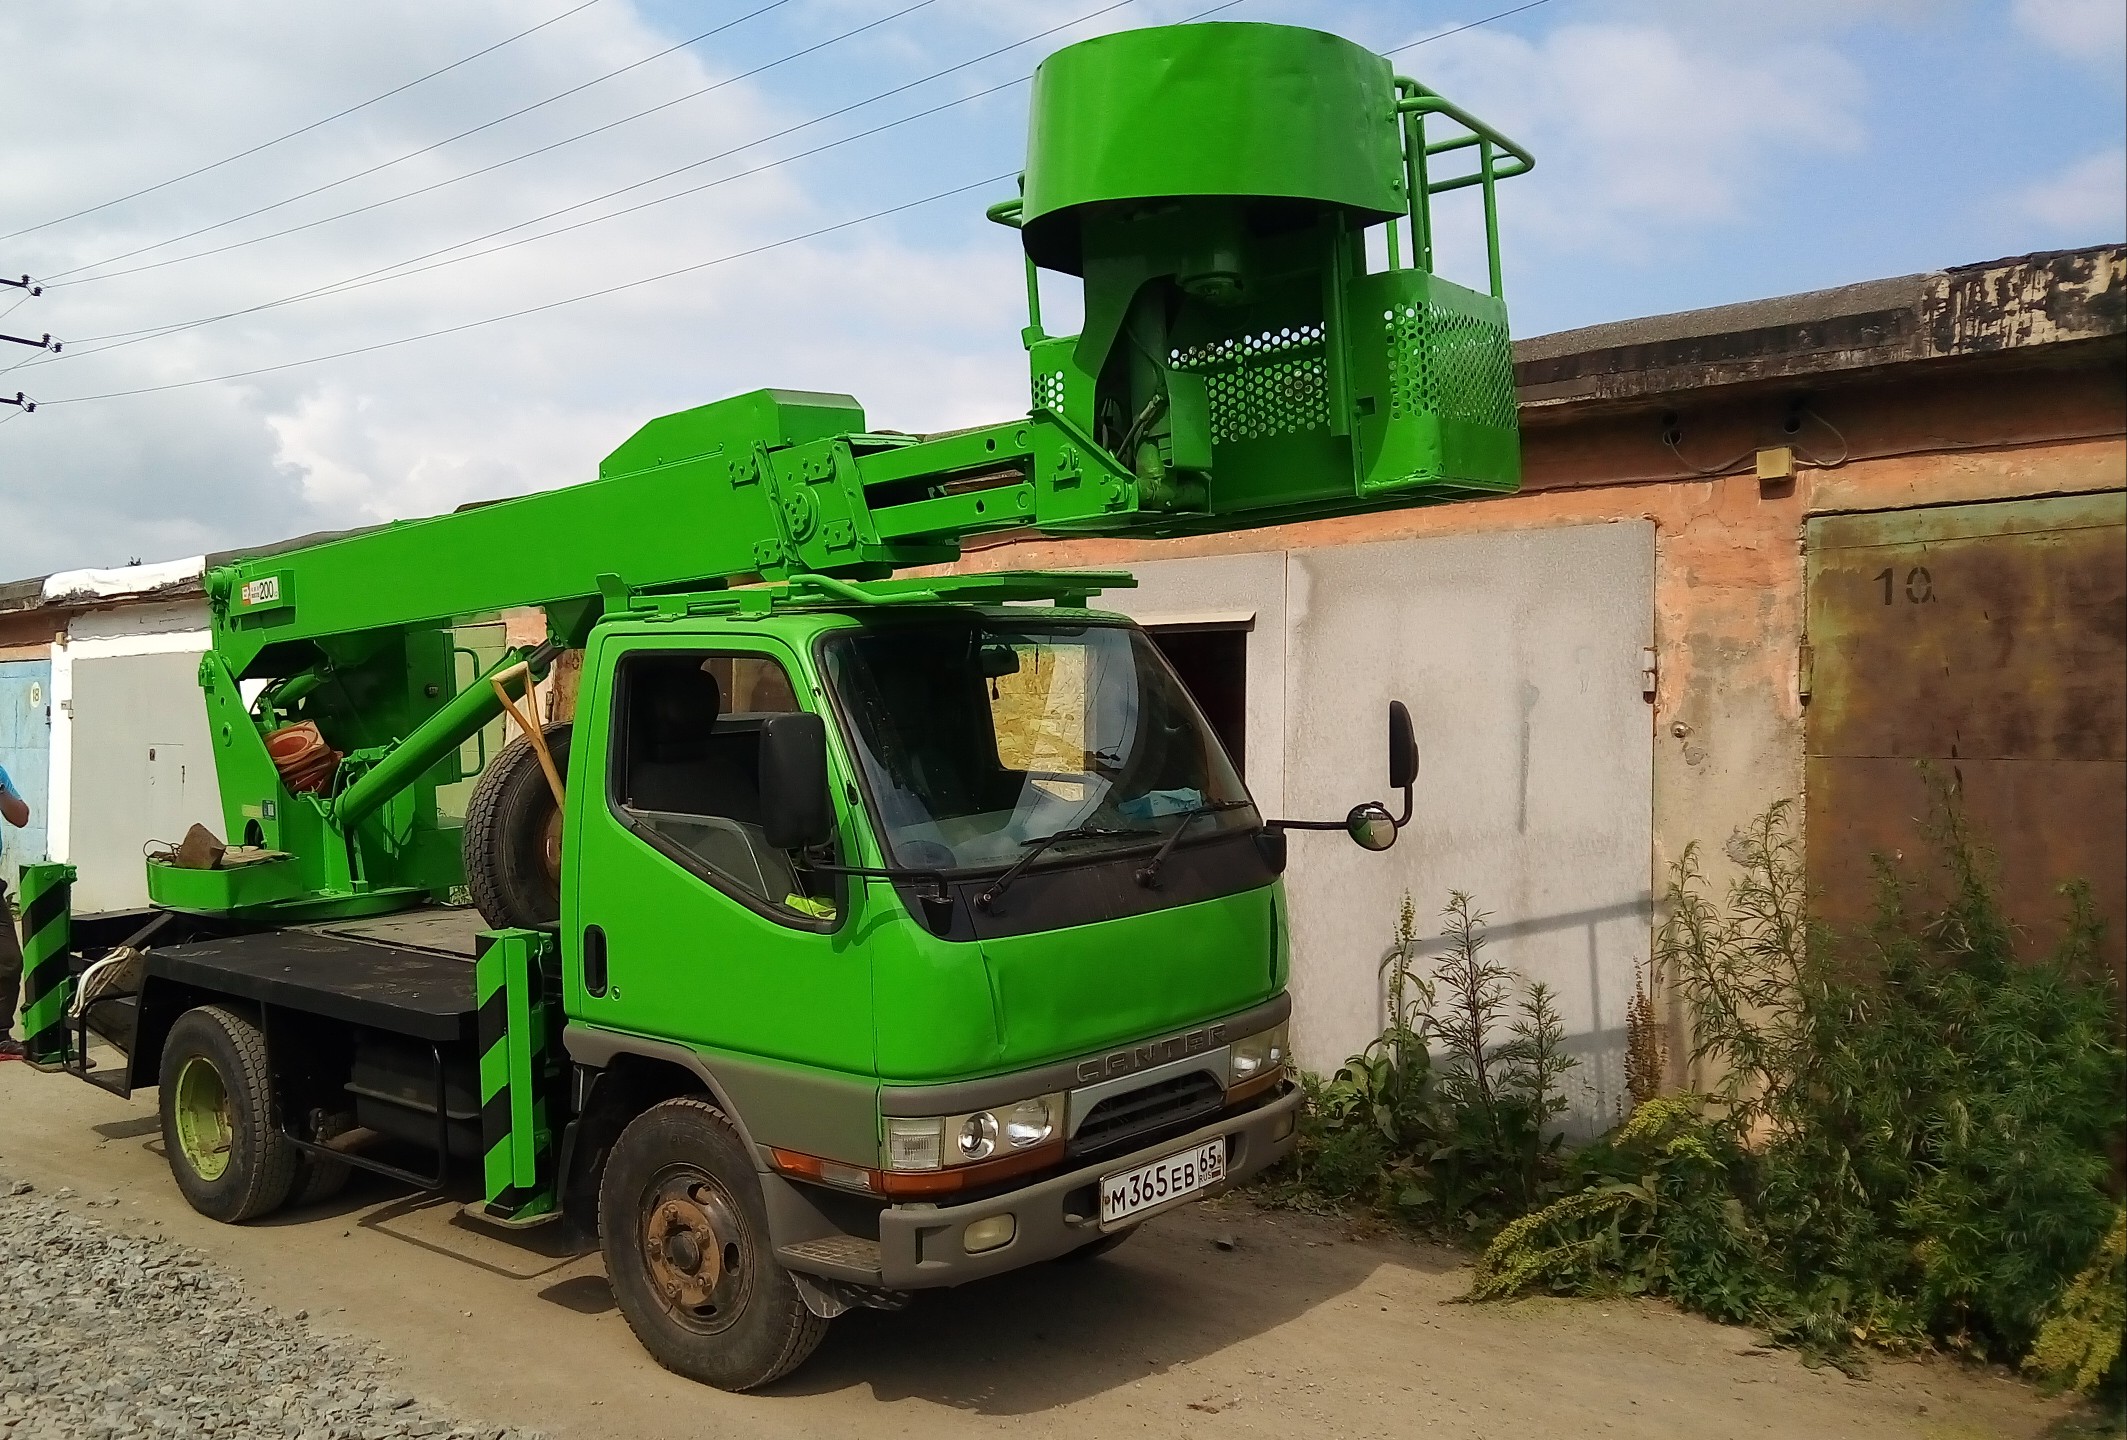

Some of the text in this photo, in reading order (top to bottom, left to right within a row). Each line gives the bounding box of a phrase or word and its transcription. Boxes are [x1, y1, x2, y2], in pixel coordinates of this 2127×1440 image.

[259, 580, 274, 600] 200
[1873, 566, 1932, 605] 10
[32, 688, 40, 702] 18
[1076, 1023, 1226, 1083] CANTER
[1199, 1145, 1217, 1173] 65
[1199, 1172, 1212, 1183] RUS
